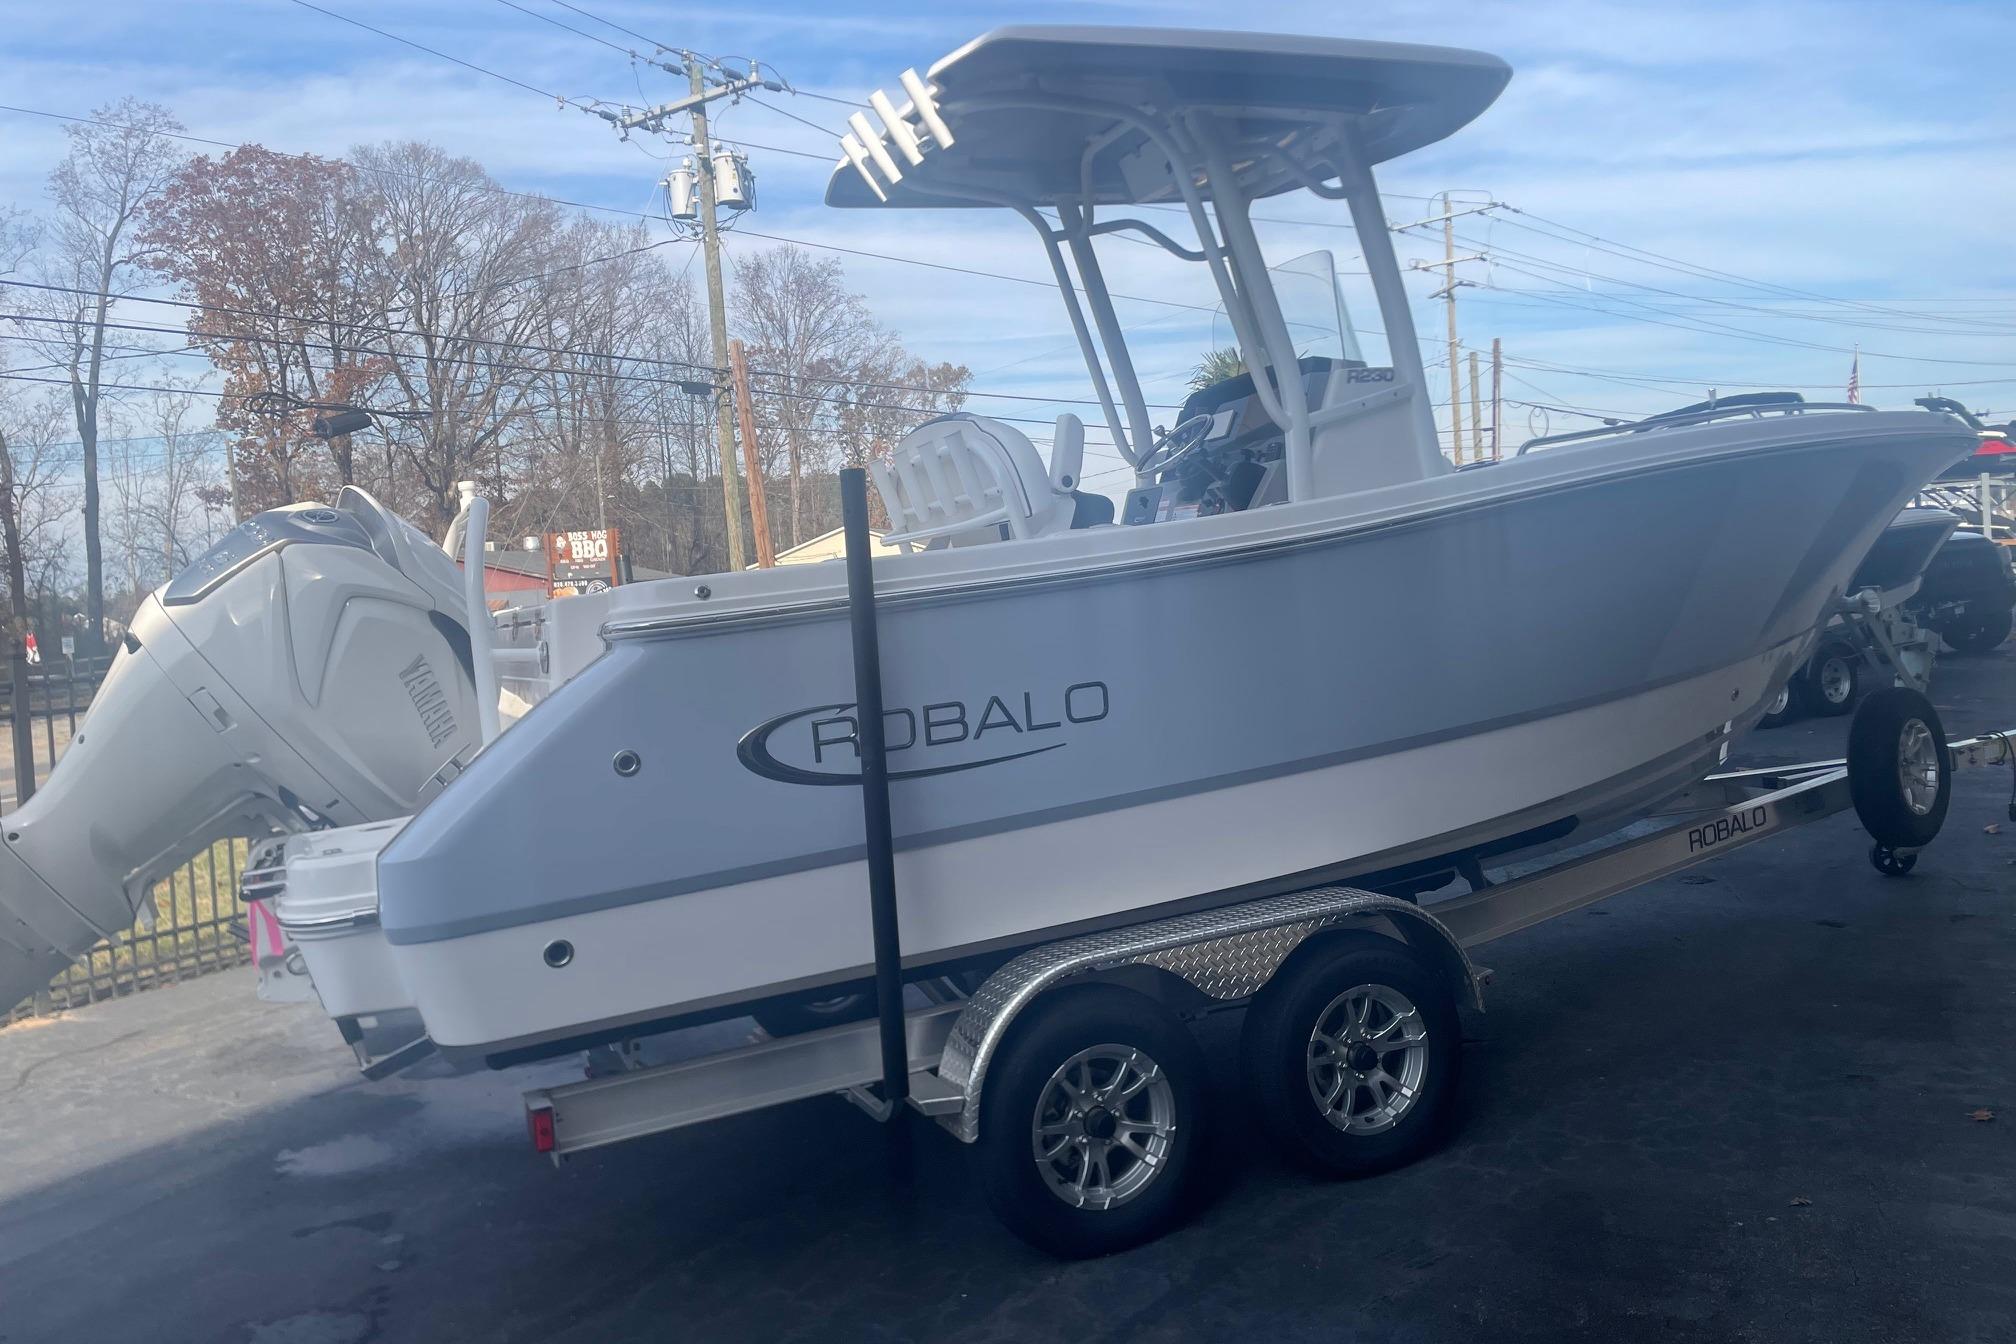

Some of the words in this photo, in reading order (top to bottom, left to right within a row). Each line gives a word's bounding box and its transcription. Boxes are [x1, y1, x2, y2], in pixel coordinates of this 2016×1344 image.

[567, 531, 588, 541] BOSS
[591, 530, 607, 540] HOG
[571, 540, 608, 559] BBQ
[399, 653, 457, 749] YAMAHA
[811, 681, 1110, 763] ROBALO
[1688, 806, 1766, 852] ROBALO
